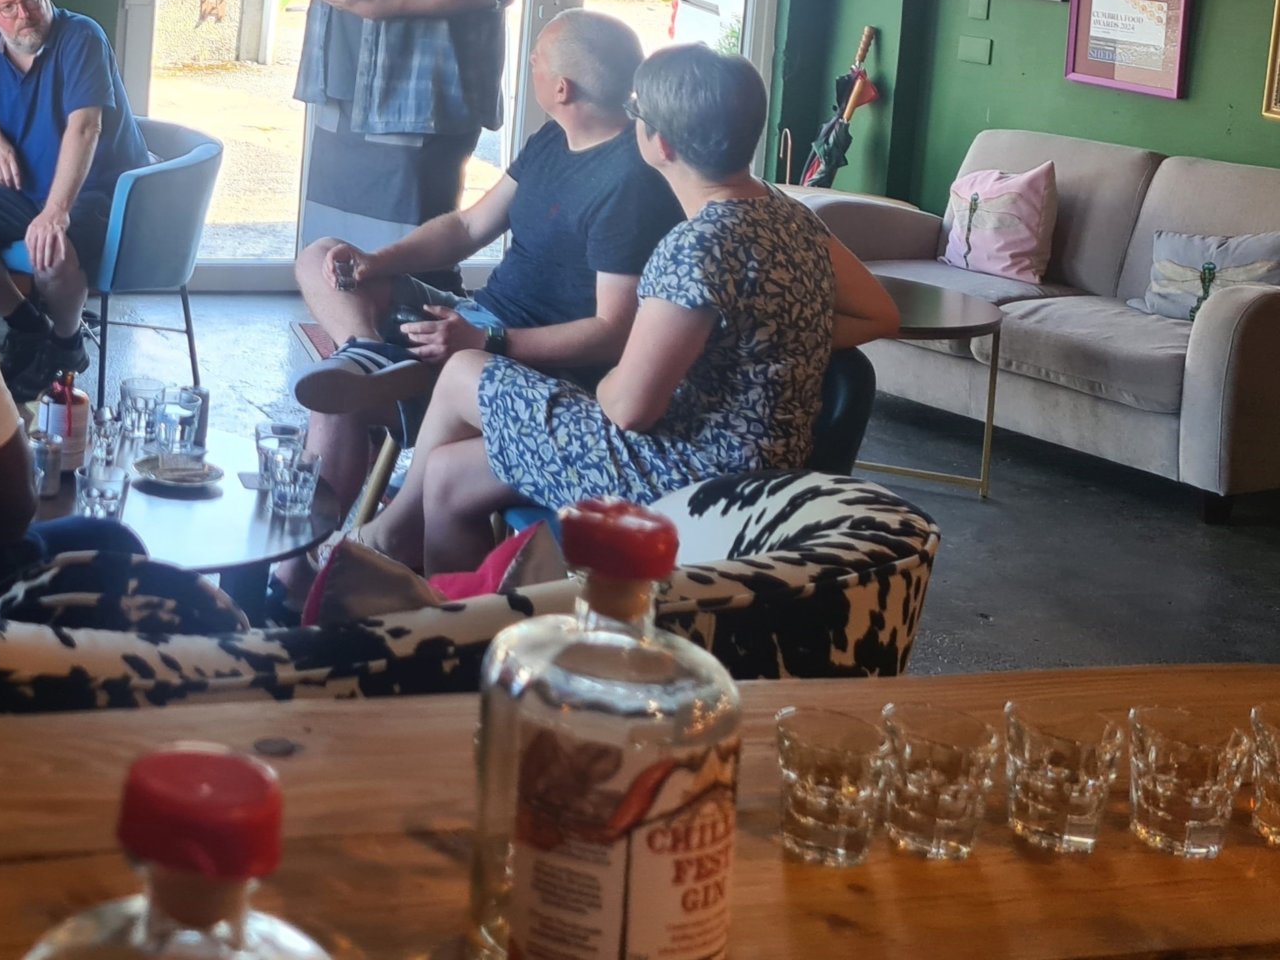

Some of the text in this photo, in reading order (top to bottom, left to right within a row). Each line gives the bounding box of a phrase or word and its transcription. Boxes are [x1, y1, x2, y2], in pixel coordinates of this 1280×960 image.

[1093, 10, 1144, 24] CUMBRIA FOOD
[1093, 19, 1119, 28] AWARDS
[681, 876, 726, 913] GIN
